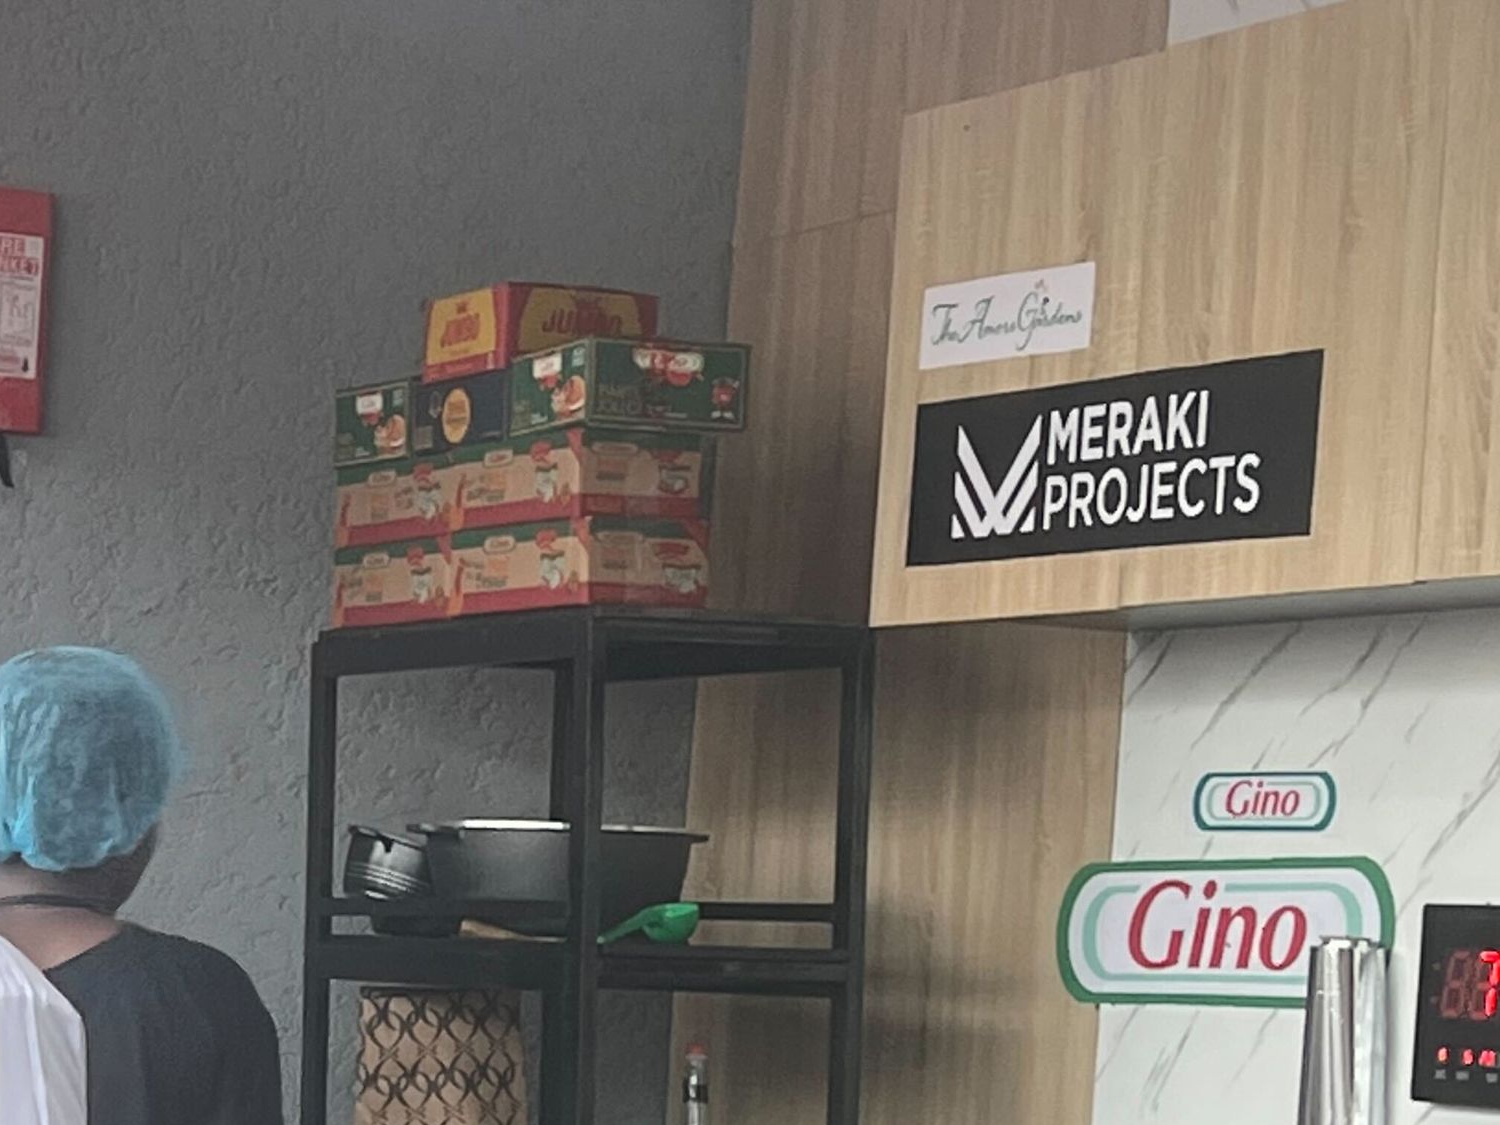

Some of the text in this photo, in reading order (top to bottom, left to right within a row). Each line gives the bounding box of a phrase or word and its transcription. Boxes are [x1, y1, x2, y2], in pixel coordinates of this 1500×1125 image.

[1046, 390, 1210, 466] MERAKI
[1042, 452, 1263, 531] PROJECTS
[1225, 780, 1300, 818] Gino
[1128, 879, 1308, 971] Gino
